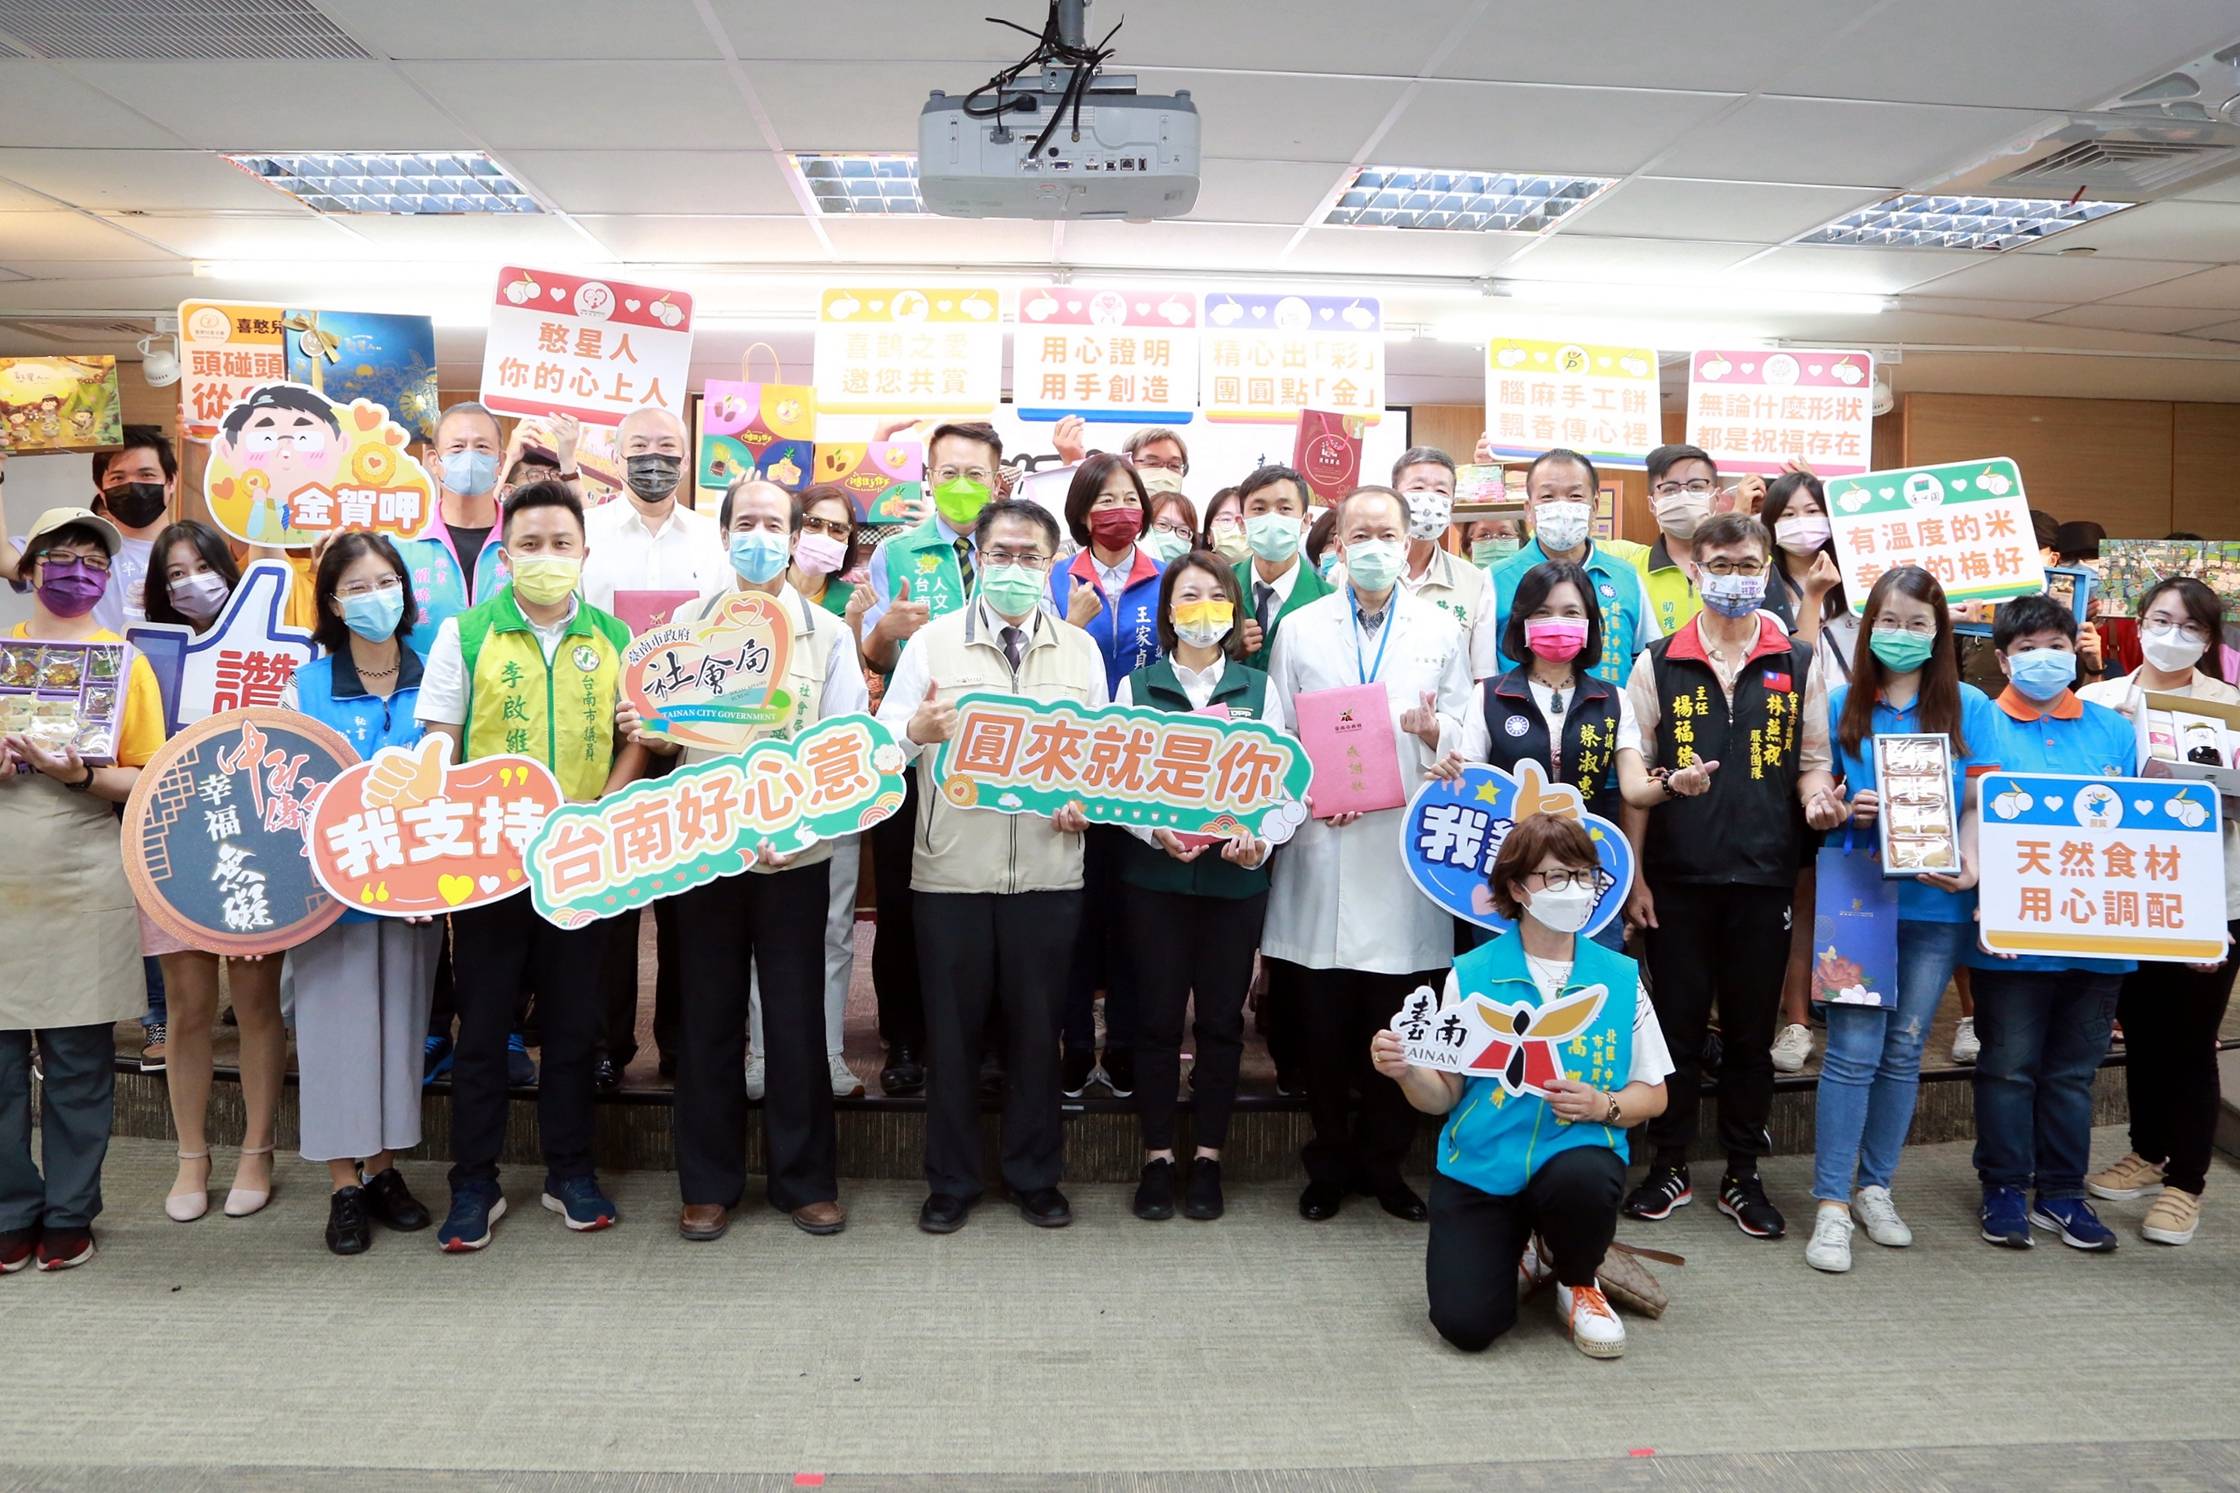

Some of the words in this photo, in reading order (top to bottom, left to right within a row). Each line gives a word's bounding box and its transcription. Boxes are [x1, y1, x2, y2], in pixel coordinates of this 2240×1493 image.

[538, 321, 638, 364] 憨星人
[1040, 336, 1171, 367] 用心證明
[1214, 340, 1374, 371] 精心出「彩」
[192, 350, 284, 379] 頭碰頭
[498, 356, 669, 408] 你的心上人
[842, 367, 967, 395] 邀您共賞
[1040, 373, 1169, 403] 用手創造
[1215, 377, 1375, 408] 團圓點「金」
[1500, 380, 1649, 415] 腦麻手工餅
[1698, 393, 1863, 422] 無論什麼形狀
[1500, 412, 1650, 448] 飄香傳心裡
[1696, 426, 1862, 456] 都是祝福存在
[293, 487, 420, 529] 金賀呷
[1846, 510, 2017, 555] 有溫度的米
[1663, 601, 1675, 630] 助理
[628, 626, 691, 663] 臺南市政府
[1135, 606, 1153, 670] 王家貞
[212, 650, 299, 715] 讚
[644, 637, 770, 700] 社會局
[581, 675, 598, 761] 台南市議員
[663, 708, 696, 720] TAINAN
[696, 708, 717, 718] CITY
[717, 710, 777, 721] GOVERNMENT
[1695, 685, 1709, 716] 主任
[1672, 694, 1695, 768] 楊福德
[1763, 693, 1787, 767] 林燕祝
[953, 711, 1284, 804] 圓來就是你
[1577, 723, 1602, 800] 蔡淑惠
[1750, 729, 1765, 780] 服務團隊
[546, 733, 870, 894] 台南好心意
[326, 796, 546, 878] 我支持
[2015, 838, 2182, 882] 天然食材
[2017, 886, 2186, 930] 用心調配
[1399, 995, 1468, 1048] 臺南
